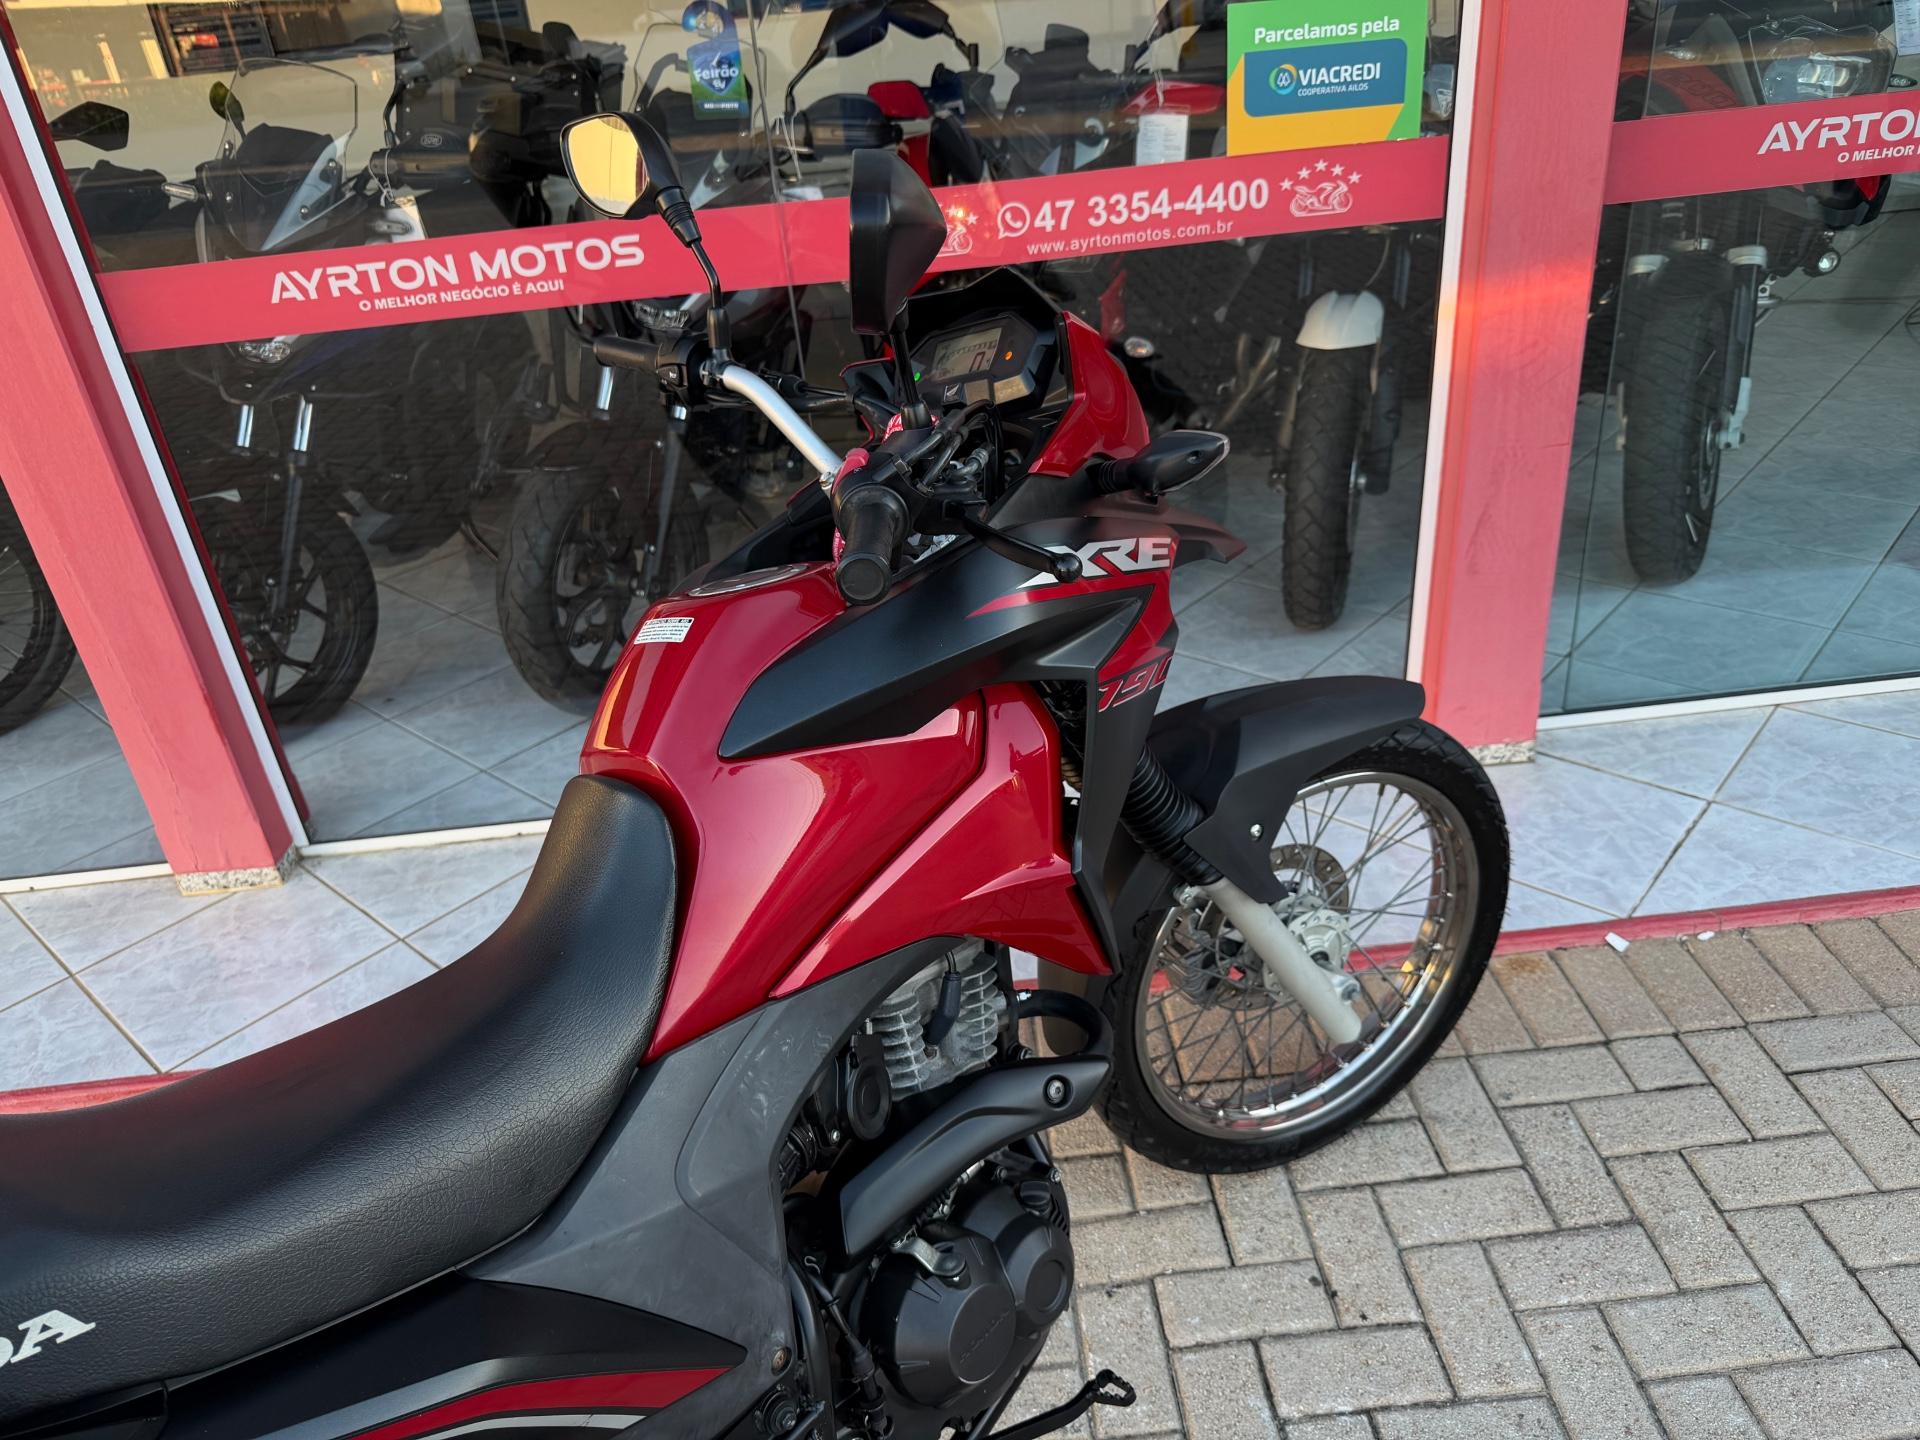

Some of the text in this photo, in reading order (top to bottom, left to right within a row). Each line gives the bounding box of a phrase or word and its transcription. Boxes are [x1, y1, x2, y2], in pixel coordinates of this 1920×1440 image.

[1254, 16, 1400, 44] Parcelamos pela
[693, 64, 739, 82] Feirão
[1298, 62, 1381, 86] VIACREDI
[1297, 82, 1369, 97] COOPERATIVA AILOS
[1756, 108, 1920, 155] AYRTO
[1837, 145, 1913, 163] O MELHOR
[1033, 178, 1269, 233] 47 3354-4400
[1026, 220, 1234, 256] www.ayrtonmotos.com.br
[271, 234, 645, 304] AYRTON MOTOS
[358, 279, 565, 311] O MELHOR NEGÓCIO É AQUI
[1016, 537, 1173, 590] XRE
